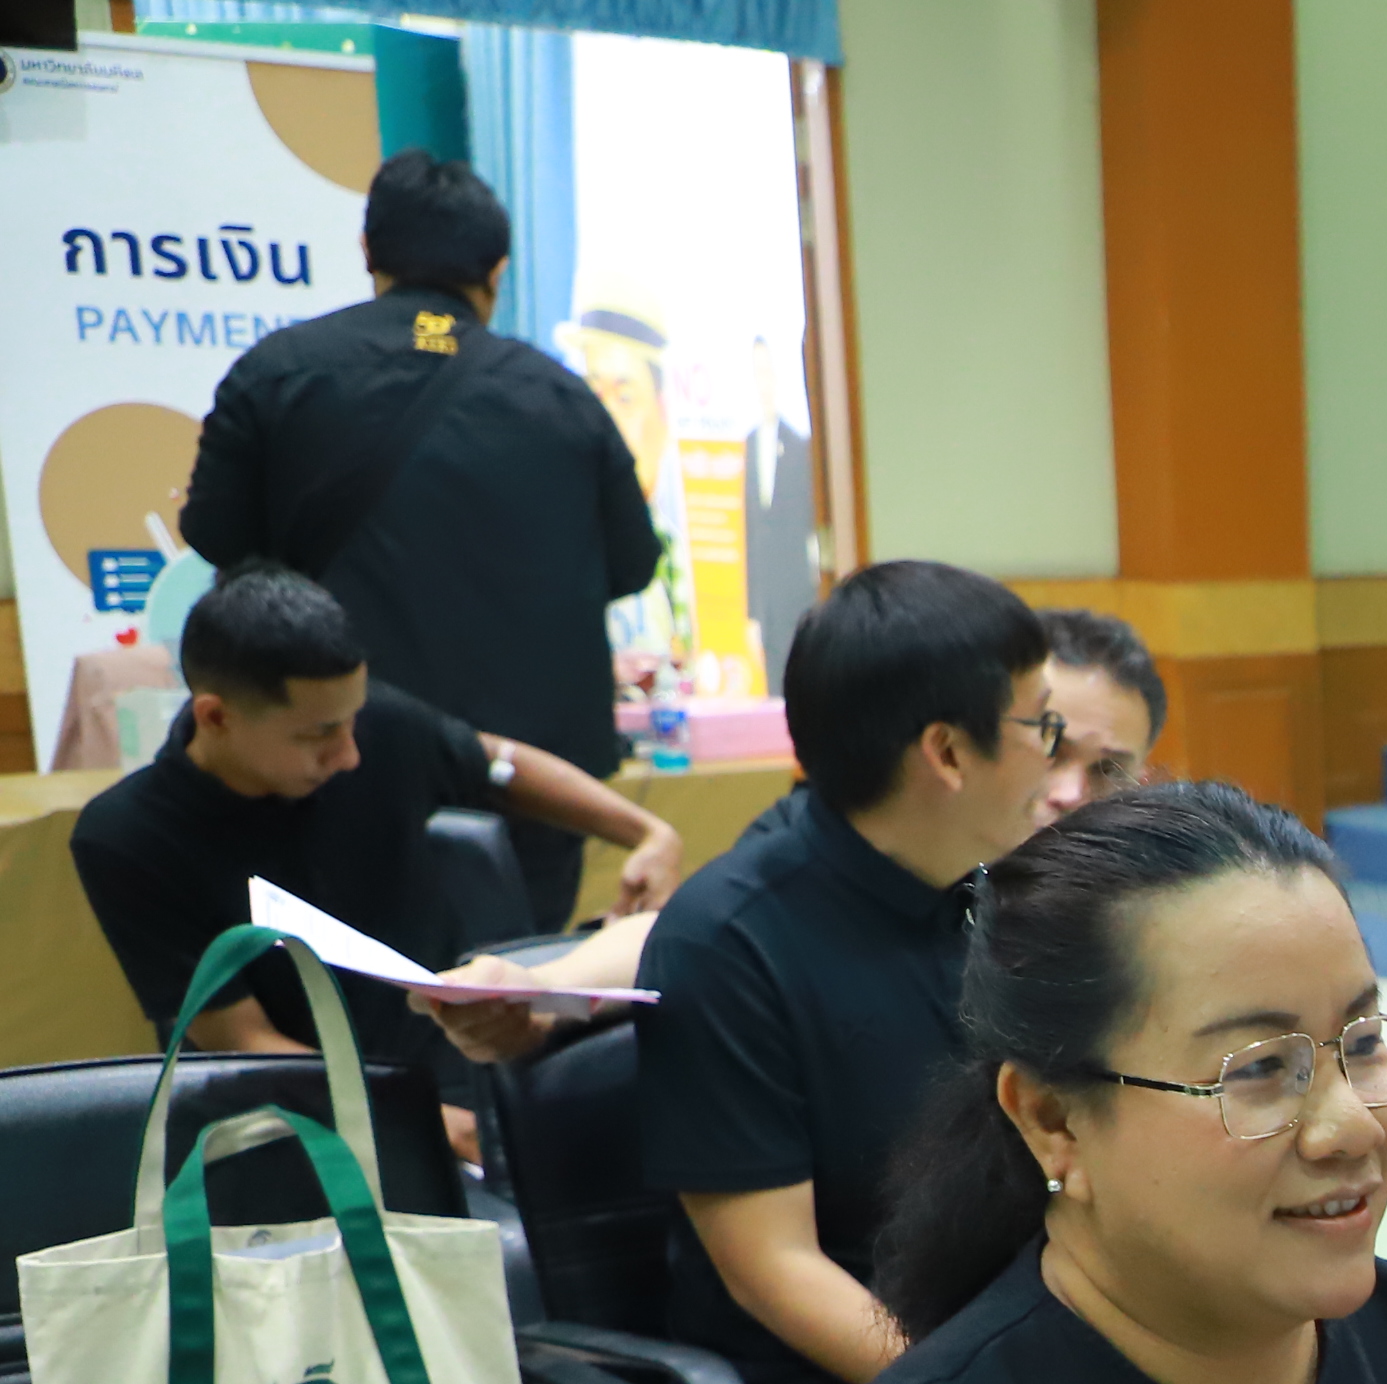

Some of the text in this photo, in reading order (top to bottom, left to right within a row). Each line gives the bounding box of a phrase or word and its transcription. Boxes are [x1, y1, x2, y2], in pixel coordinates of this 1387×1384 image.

[62, 224, 312, 287] การเงิน
[75, 305, 310, 350] PAYMEN
